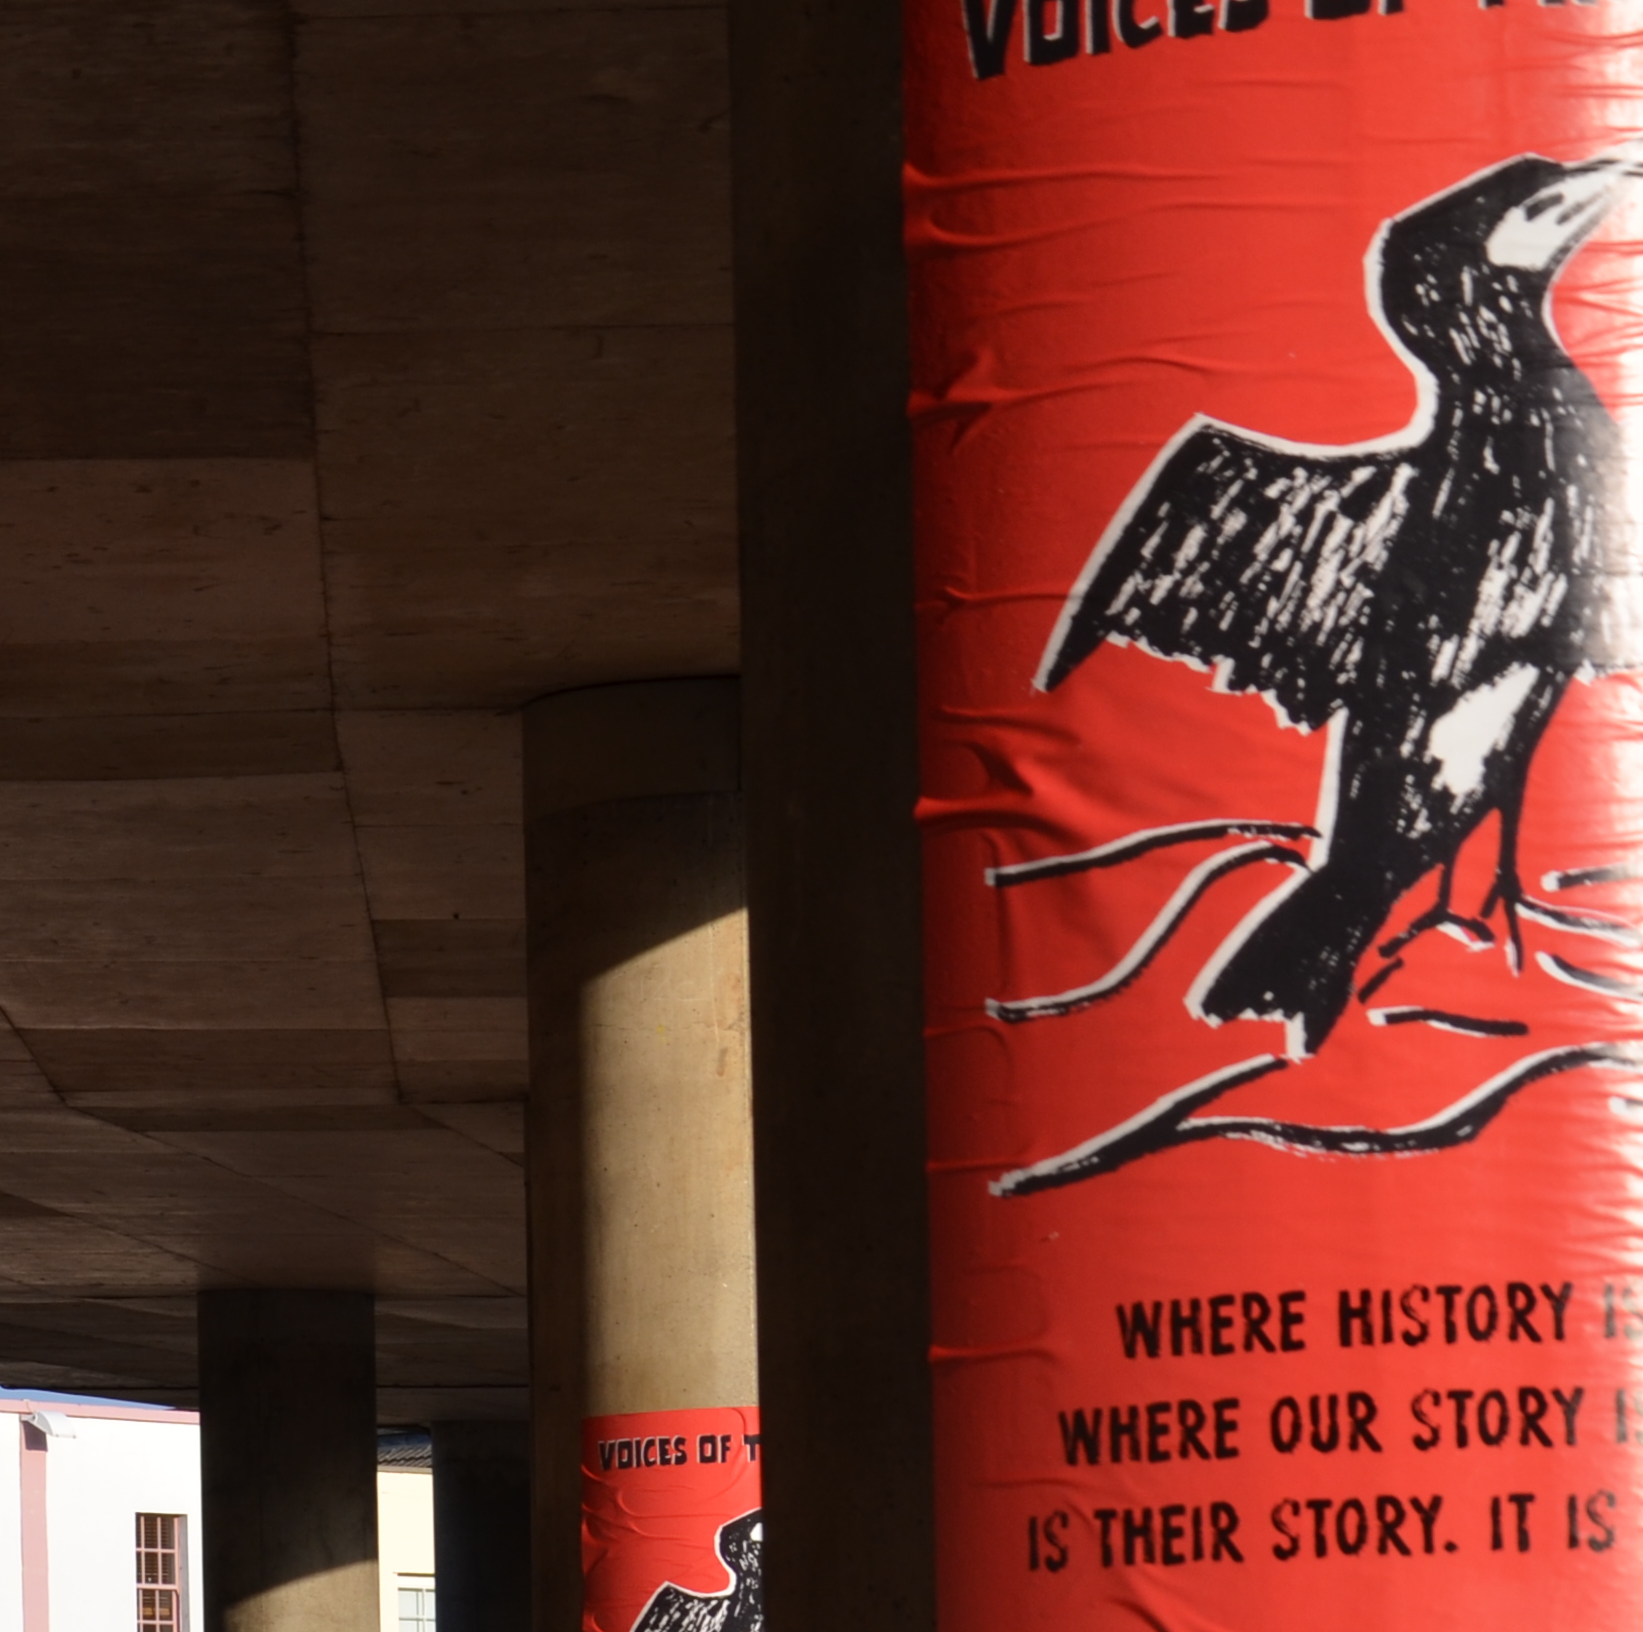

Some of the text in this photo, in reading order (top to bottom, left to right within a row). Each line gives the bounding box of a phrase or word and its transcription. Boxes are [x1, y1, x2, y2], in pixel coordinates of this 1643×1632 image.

[1115, 1290, 1306, 1360] WHERE
[1338, 1282, 1573, 1348] HISTORY
[599, 1436, 687, 1471] VOICES
[696, 1434, 731, 1464] OF
[1059, 1397, 1240, 1466] WHERE
[1270, 1391, 1382, 1453] OUR
[1411, 1386, 1584, 1452] STORY
[1027, 1489, 1616, 1573] IS THEIR STORY. IT IS
